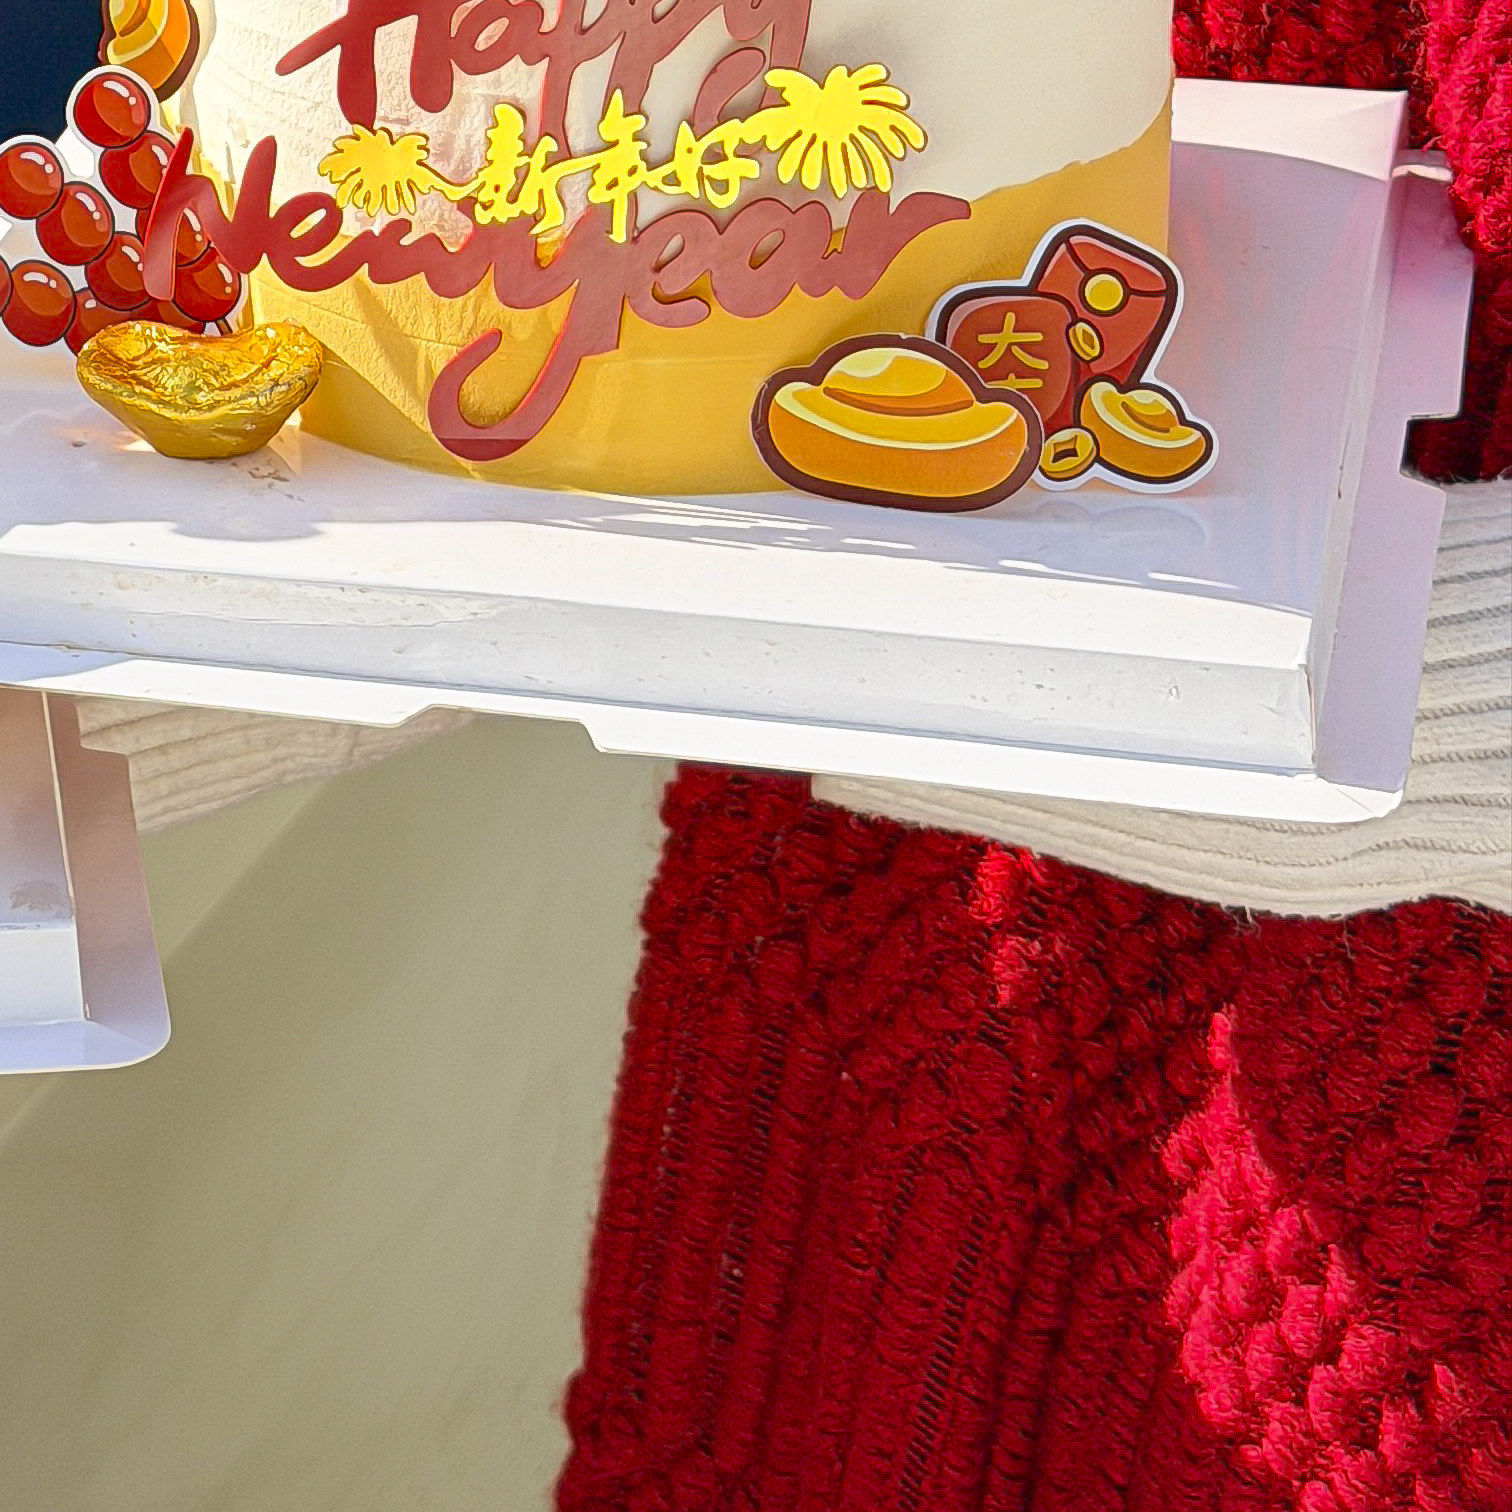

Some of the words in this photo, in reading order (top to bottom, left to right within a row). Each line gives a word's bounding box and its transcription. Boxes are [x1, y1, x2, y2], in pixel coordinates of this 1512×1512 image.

[475, 88, 761, 244] 新年好
[977, 311, 1050, 387] 大
